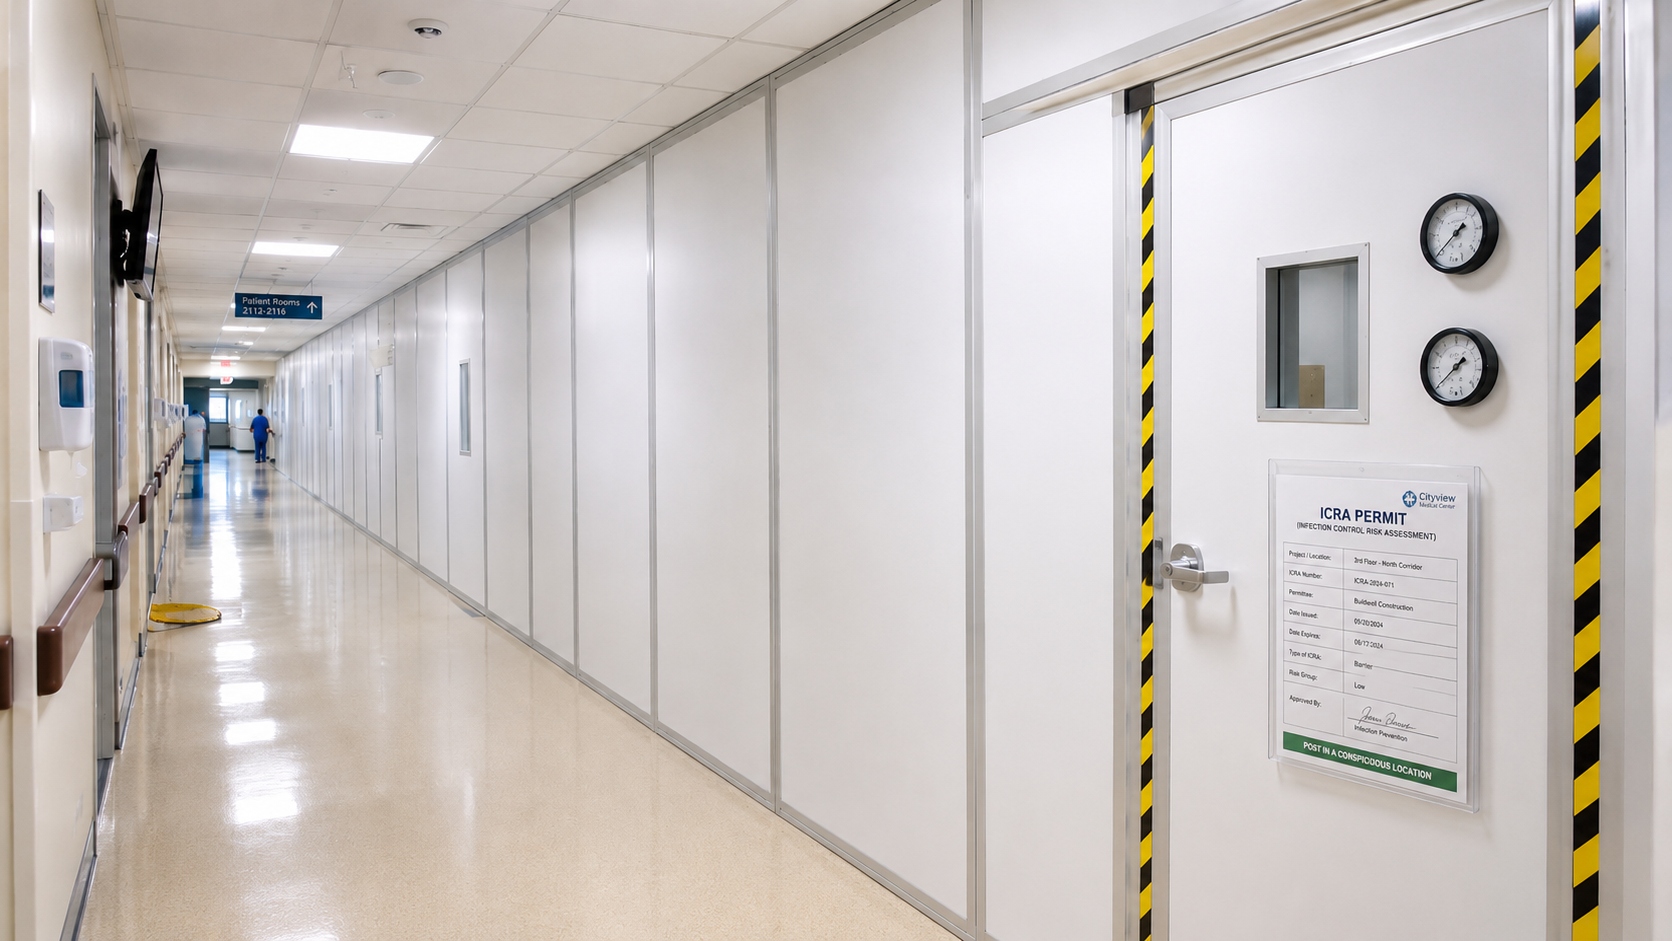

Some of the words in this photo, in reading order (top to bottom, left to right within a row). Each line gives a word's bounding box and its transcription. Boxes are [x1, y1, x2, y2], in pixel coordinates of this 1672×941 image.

[242, 297, 271, 305] Patient
[272, 298, 300, 306] Rooms
[1419, 492, 1456, 503] Cityview
[1320, 507, 1351, 521] ICRA
[1355, 509, 1407, 525] PERMIT
[1296, 522, 1332, 531] (INFECTION
[1333, 524, 1365, 534] CONTROL
[1366, 527, 1383, 535] RISK
[1384, 529, 1437, 541] ASSESSMENT)
[1289, 550, 1305, 558] Project
[1398, 562, 1423, 570] Corridor
[1378, 601, 1413, 611] Construction
[1354, 682, 1365, 690] Low
[1303, 741, 1321, 752] POST
[1322, 746, 1330, 755] IN
[1331, 749, 1337, 757] A
[1392, 764, 1432, 780] LOCATION
